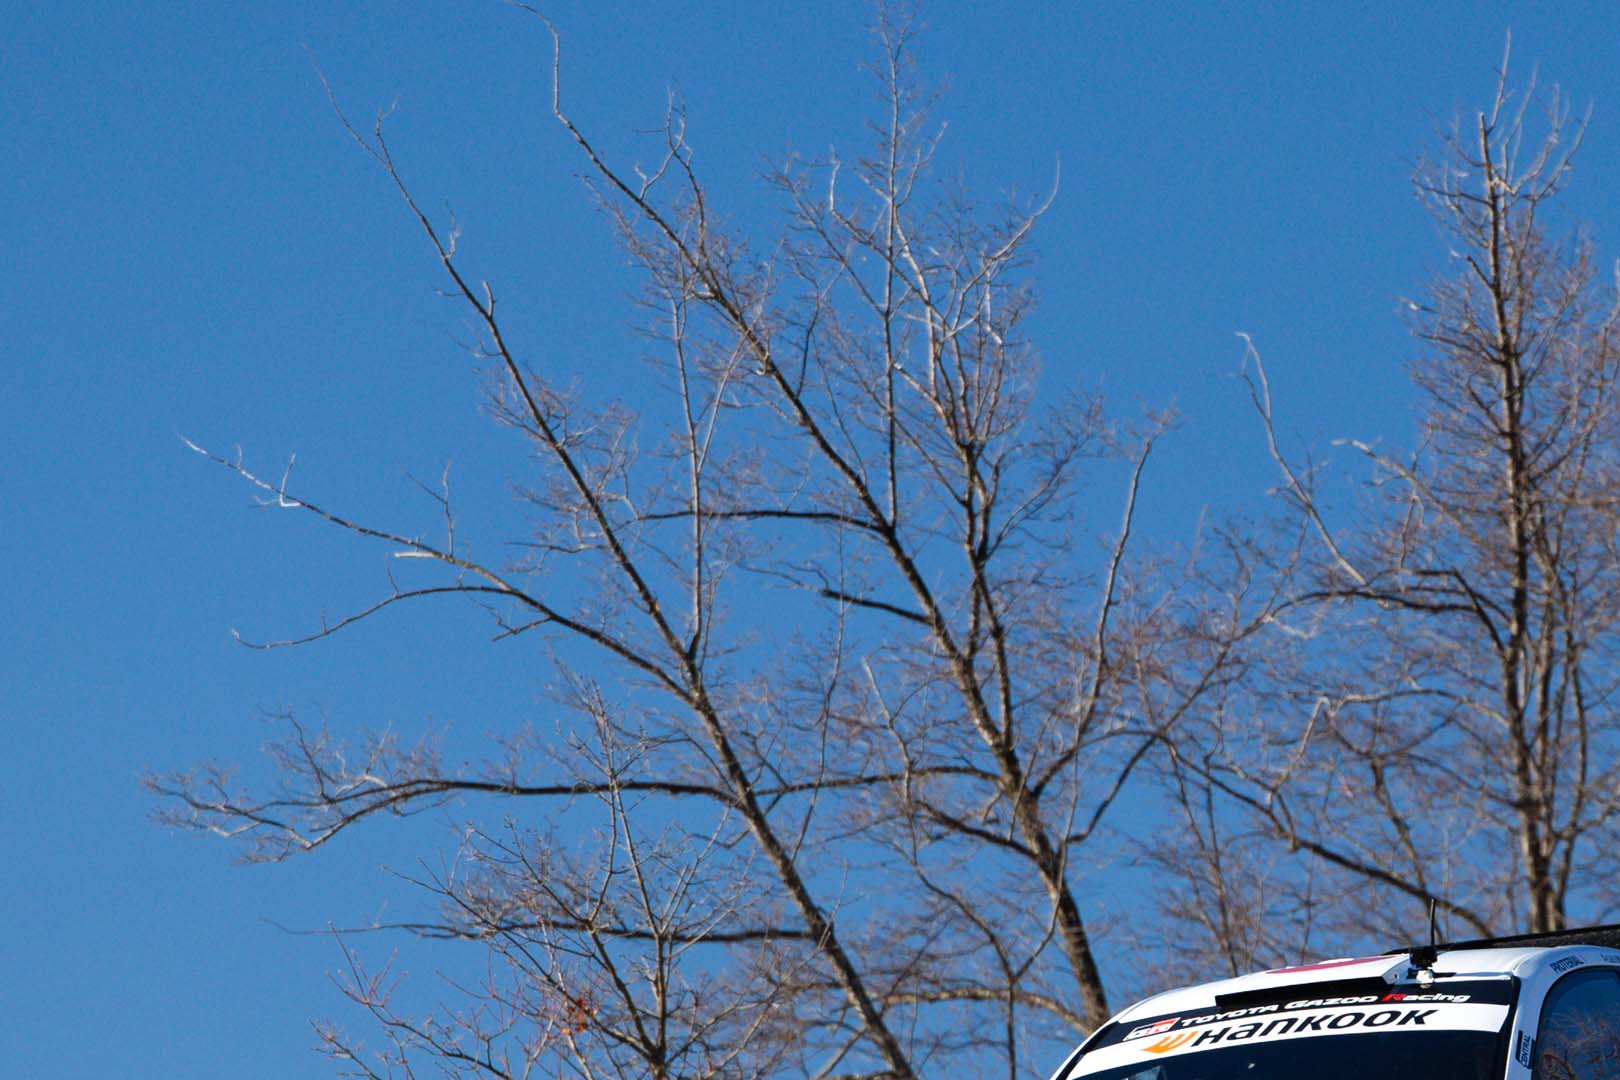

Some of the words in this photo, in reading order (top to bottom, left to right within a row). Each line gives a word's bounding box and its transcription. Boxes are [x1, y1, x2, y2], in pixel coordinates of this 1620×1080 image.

[1181, 1003, 1280, 1027] TOYOTA
[1285, 994, 1379, 1011] GAZOO
[1381, 992, 1471, 1004] Racing
